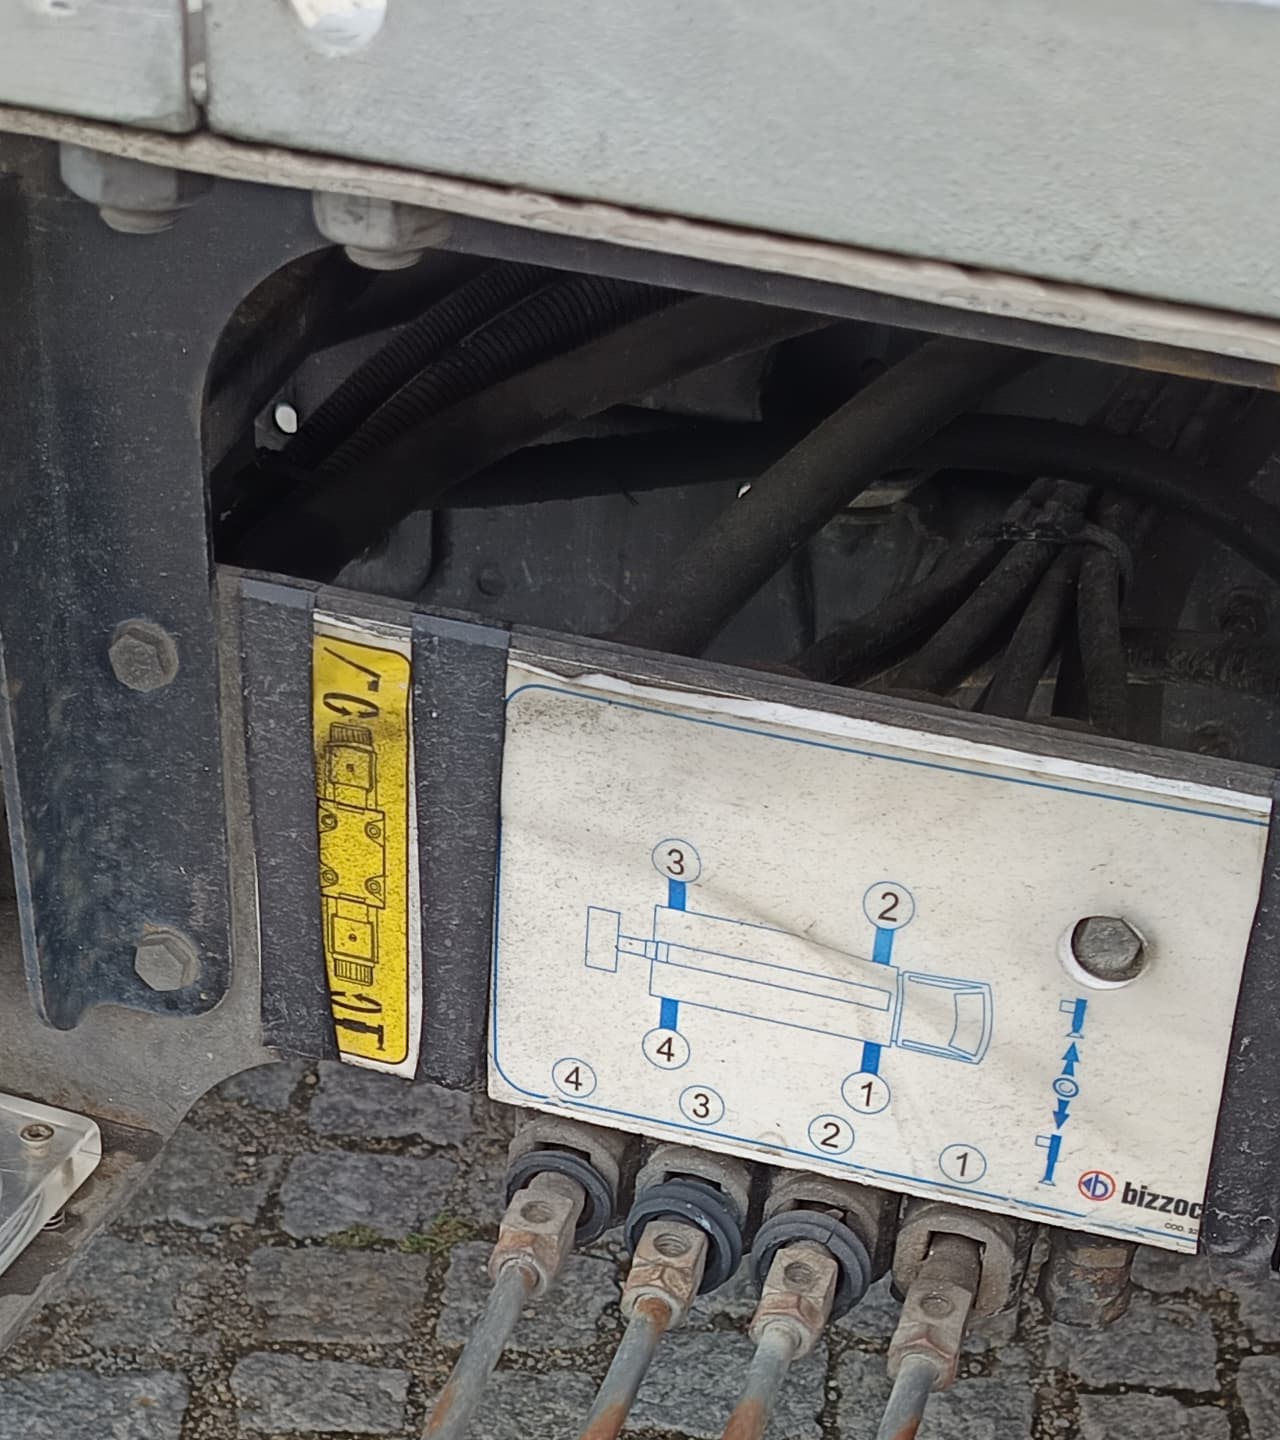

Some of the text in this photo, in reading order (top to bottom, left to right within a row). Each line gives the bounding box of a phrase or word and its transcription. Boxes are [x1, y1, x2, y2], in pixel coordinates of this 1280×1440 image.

[666, 848, 685, 876] 3
[878, 891, 899, 922] 2
[656, 1037, 675, 1062] 4
[564, 1066, 583, 1091] 4
[692, 1093, 710, 1119] 3
[861, 1081, 873, 1107] 1
[820, 1122, 841, 1149] 2
[956, 1152, 968, 1177] 1
[1121, 1181, 1203, 1220] bizzoc
